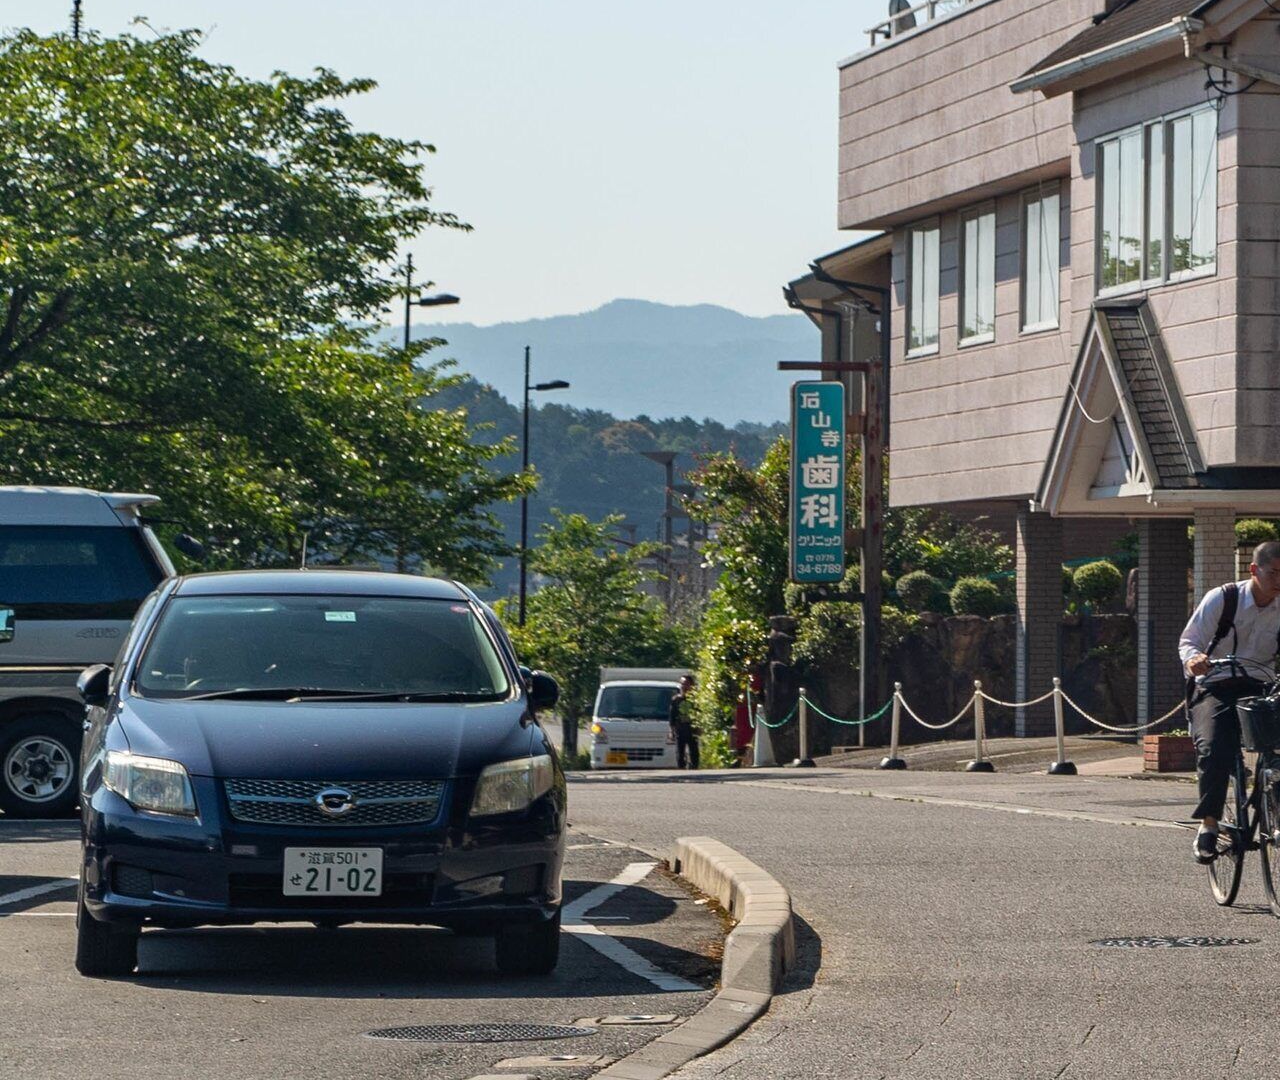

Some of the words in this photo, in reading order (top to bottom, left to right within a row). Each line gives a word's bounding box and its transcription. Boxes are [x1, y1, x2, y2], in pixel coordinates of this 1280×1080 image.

[799, 391, 841, 448] 石山寺
[800, 454, 840, 529] 歯科
[797, 535, 842, 547] クリニック
[797, 563, 842, 574] 34-6789
[289, 873, 303, 886] せ
[305, 867, 377, 892] 21-02
